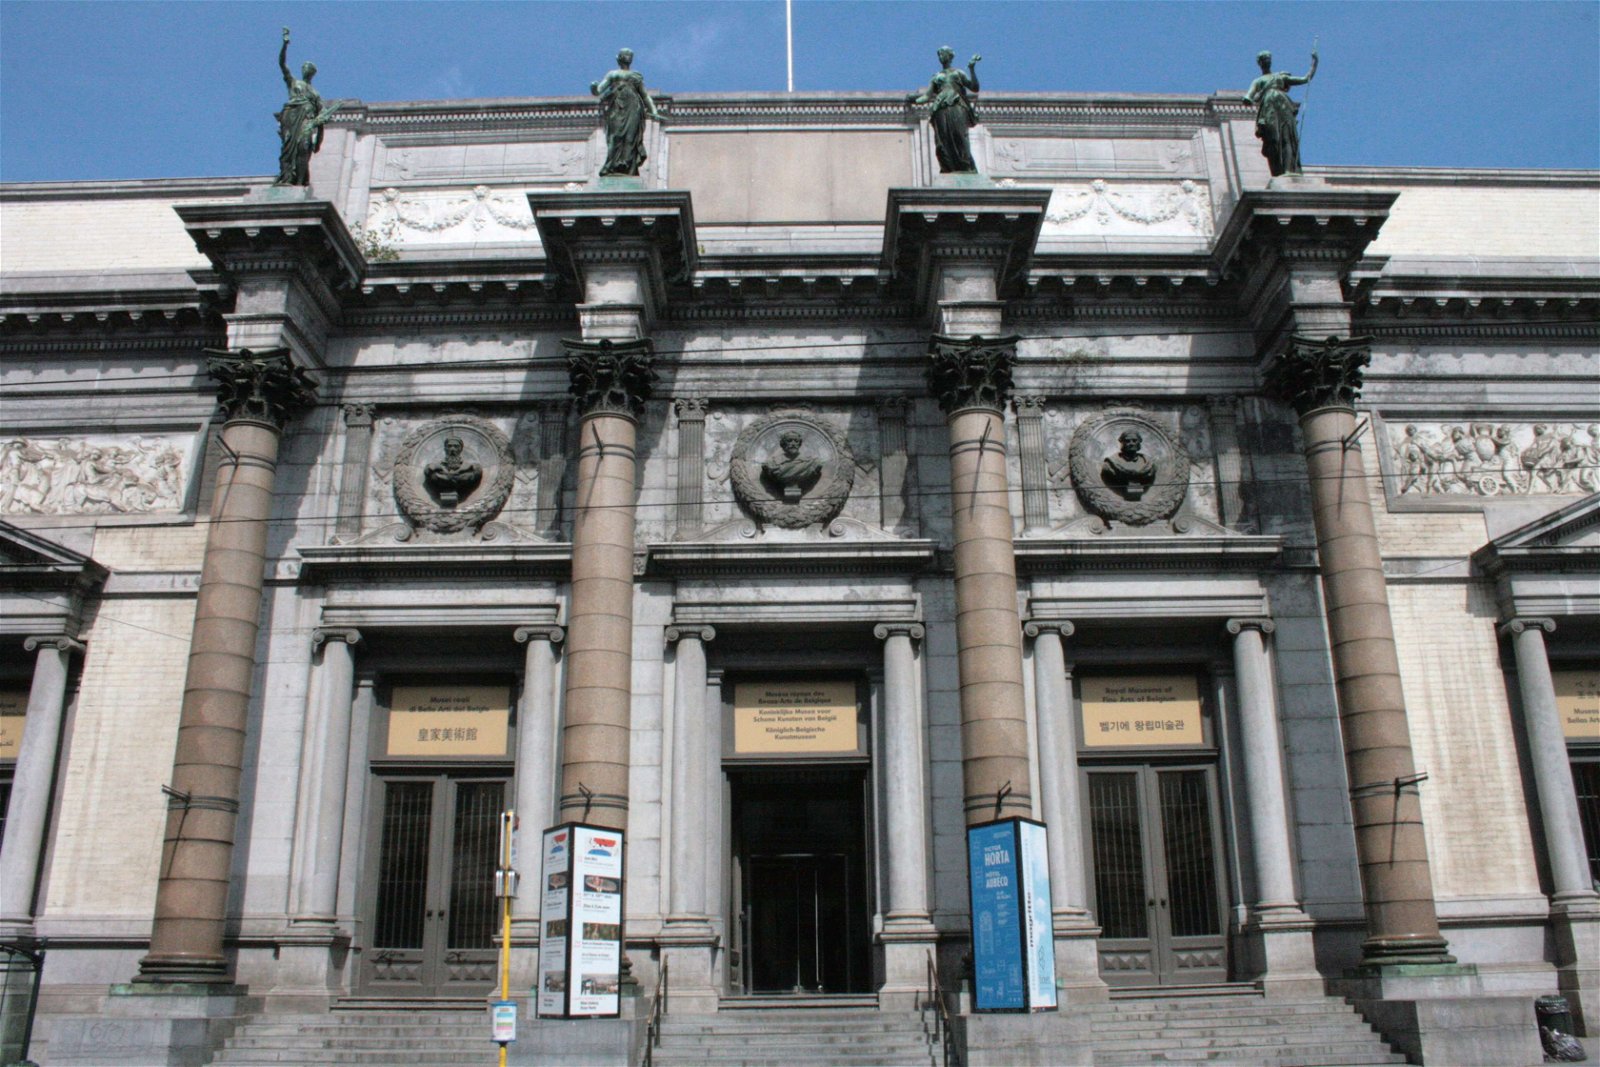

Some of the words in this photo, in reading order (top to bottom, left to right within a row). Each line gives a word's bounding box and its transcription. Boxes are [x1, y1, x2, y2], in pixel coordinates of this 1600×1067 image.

[1105, 687, 1126, 695] Royal
[804, 697, 832, 705] Belgique
[1102, 695, 1117, 703] Fine
[1120, 695, 1135, 703] Arts
[1137, 695, 1145, 703] of
[1146, 695, 1177, 704] Belgium
[1099, 720, 1130, 732] 벨기에
[1134, 719, 1184, 731] 왕립미술관
[417, 727, 479, 741] 皇家美術館
[984, 850, 1010, 867] HORTA
